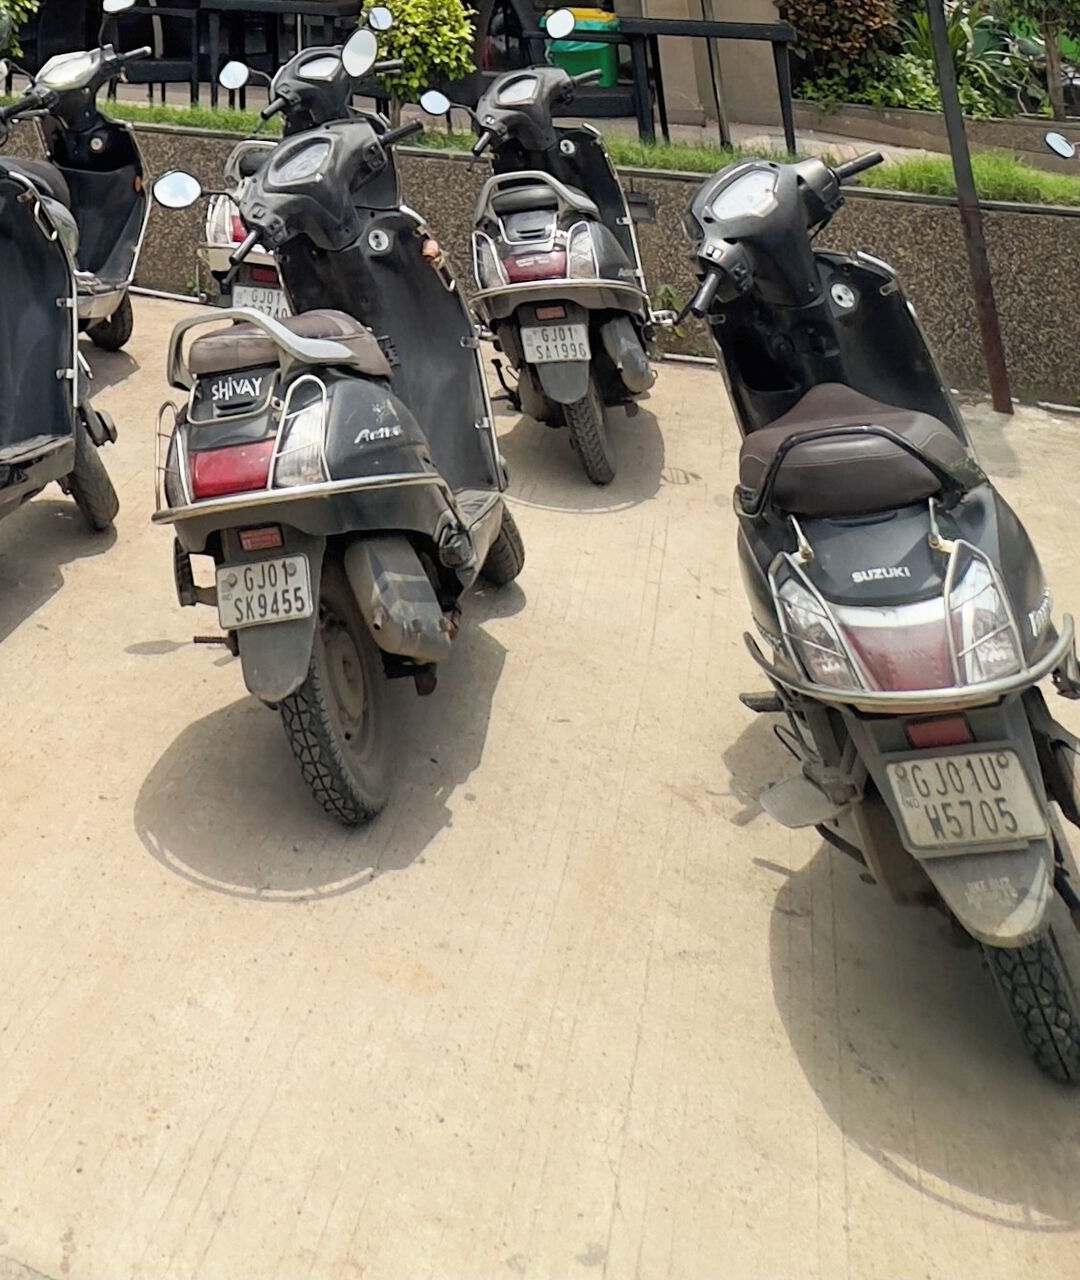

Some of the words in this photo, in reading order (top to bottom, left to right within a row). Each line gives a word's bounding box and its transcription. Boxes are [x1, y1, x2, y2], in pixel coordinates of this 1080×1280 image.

[251, 288, 281, 306] GJ01
[541, 326, 575, 342] GJ01
[243, 560, 289, 592] GJ01
[851, 565, 911, 584] SUZUKI
[233, 586, 305, 623] SK9455
[911, 755, 1003, 798] GJ01U
